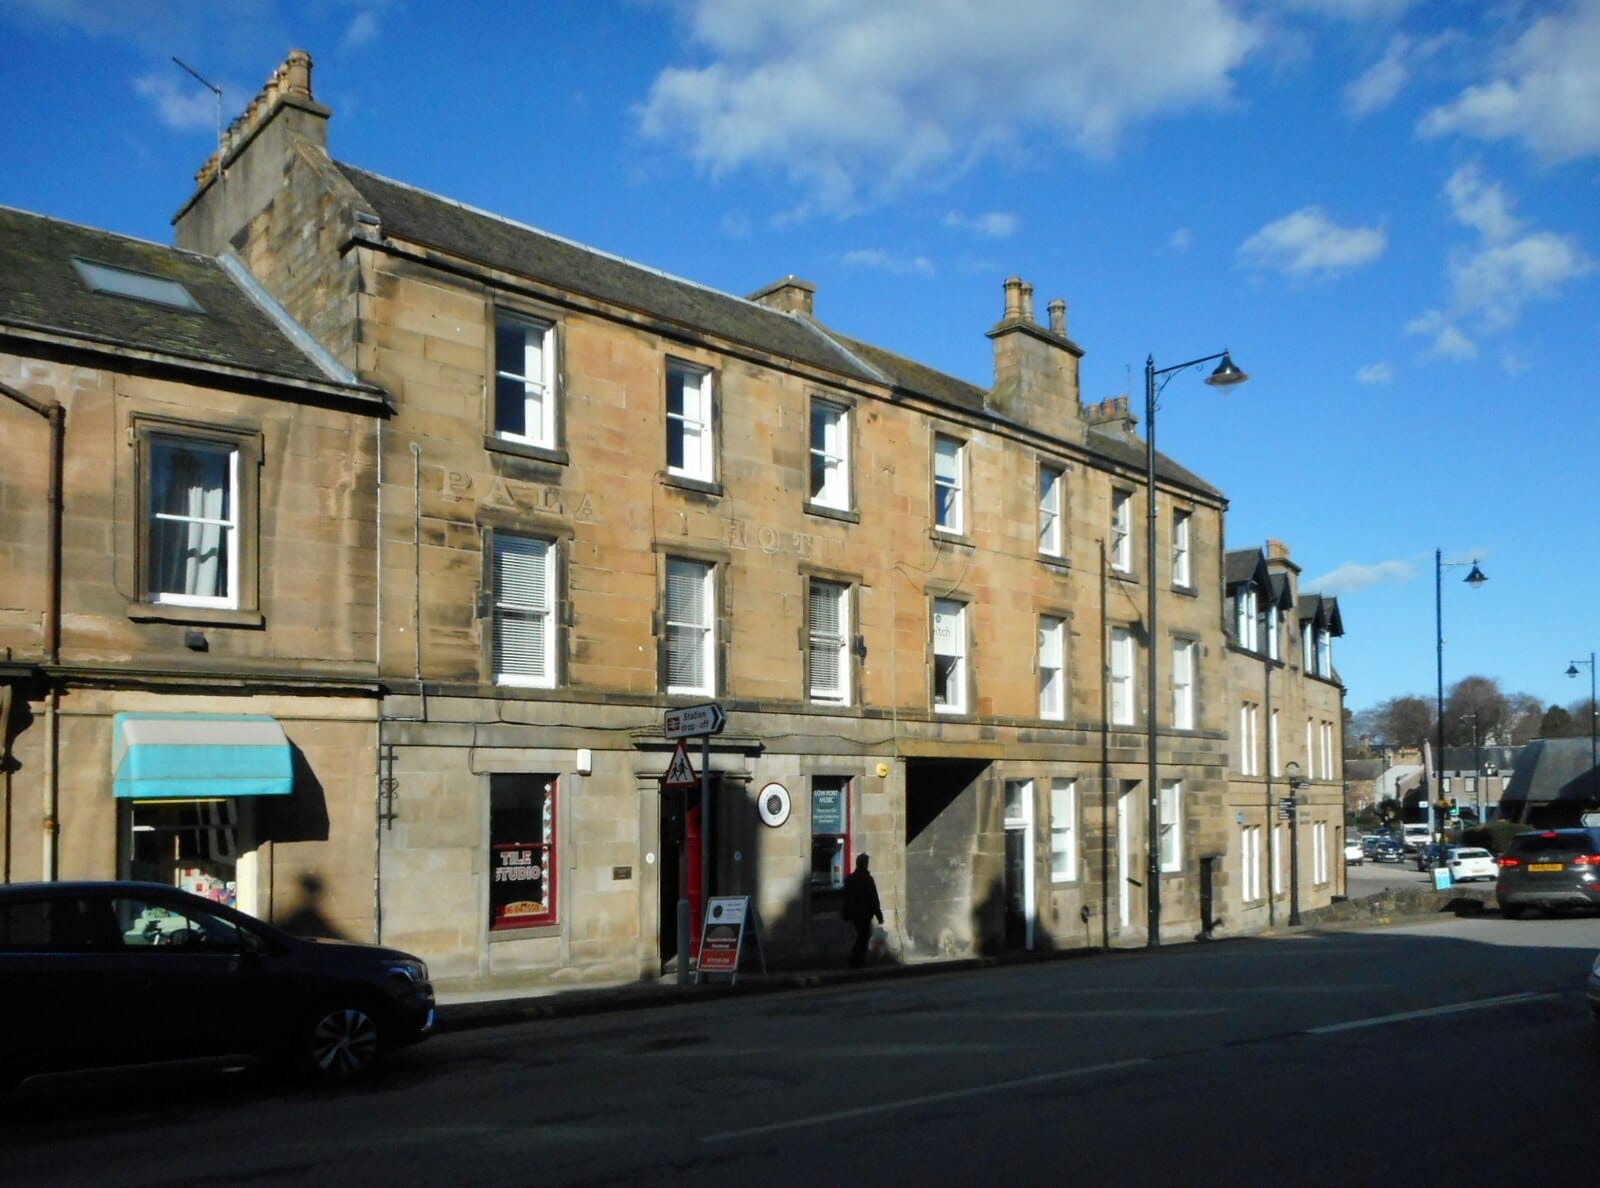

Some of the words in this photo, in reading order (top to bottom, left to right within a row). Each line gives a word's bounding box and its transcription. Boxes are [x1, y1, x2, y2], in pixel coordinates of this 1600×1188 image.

[683, 711, 705, 721] Station
[500, 851, 531, 866] TILE
[495, 865, 541, 882] STUDIO
